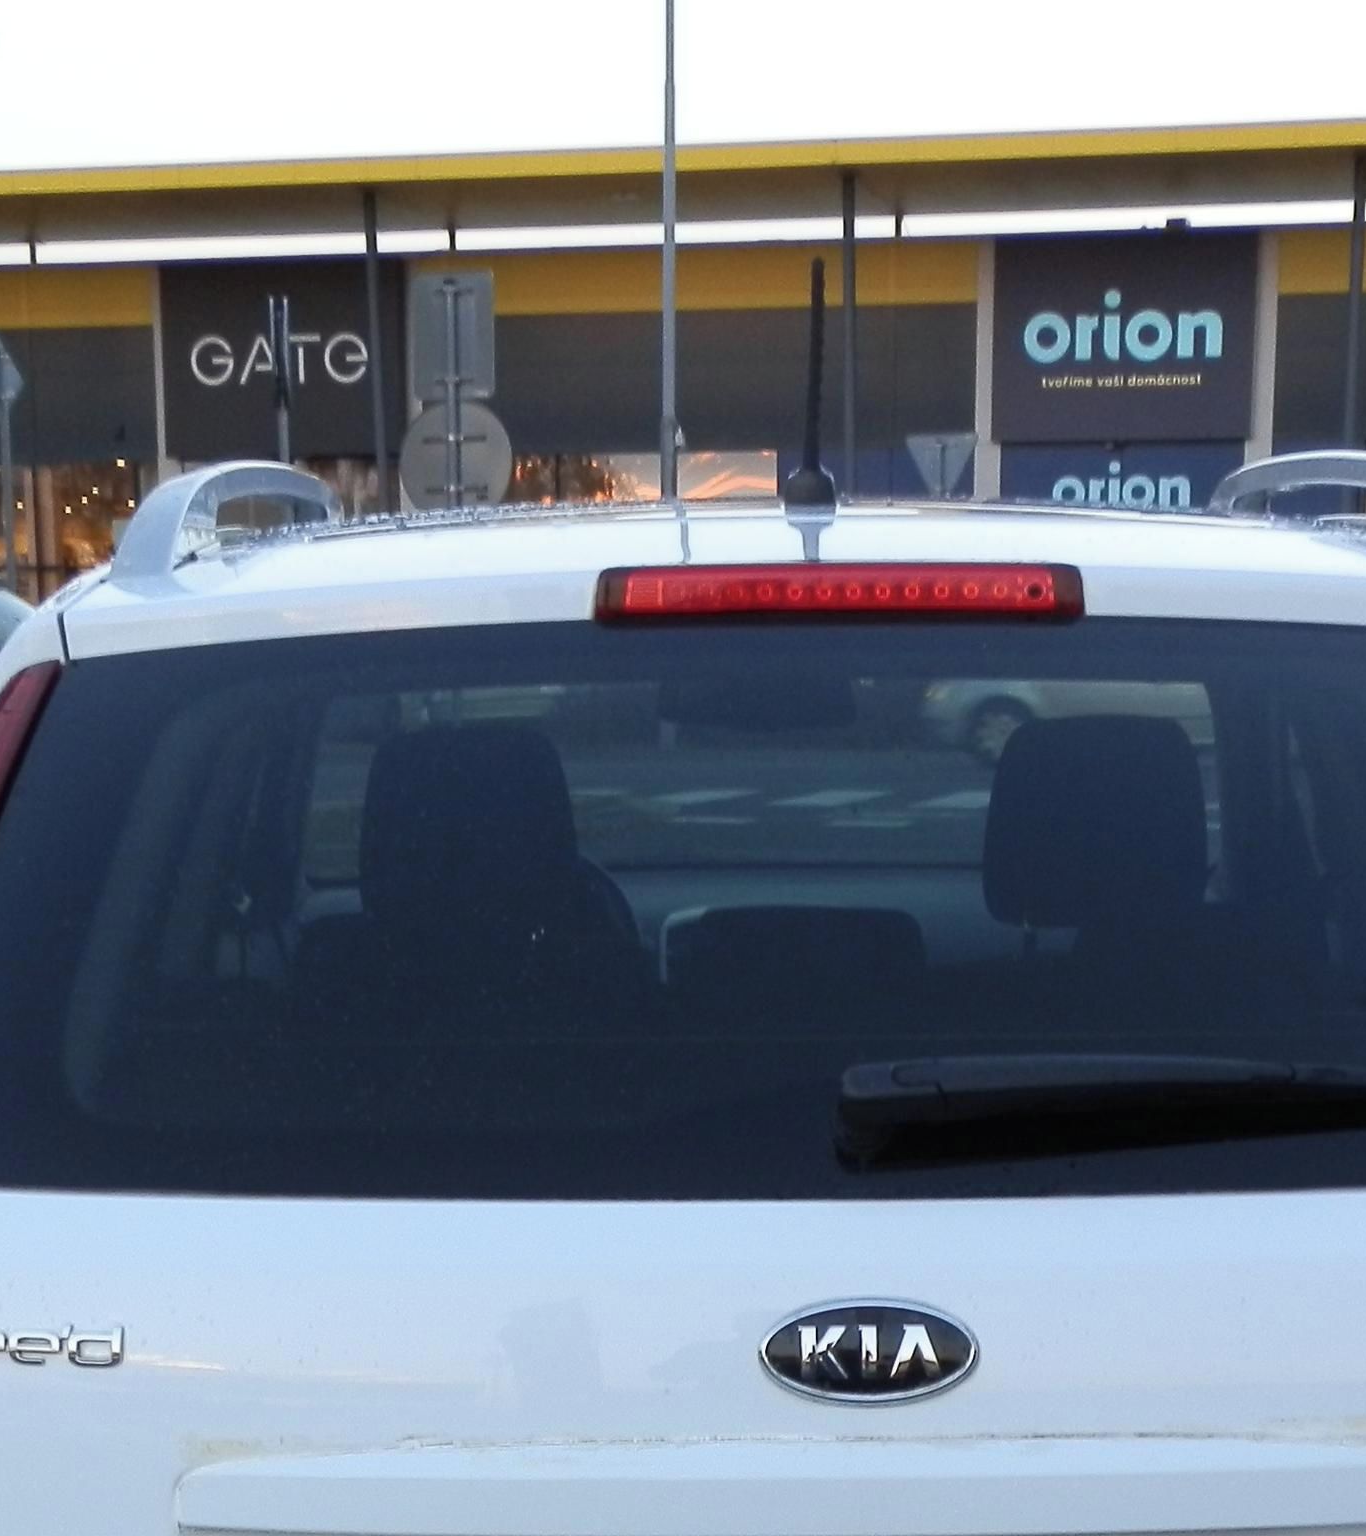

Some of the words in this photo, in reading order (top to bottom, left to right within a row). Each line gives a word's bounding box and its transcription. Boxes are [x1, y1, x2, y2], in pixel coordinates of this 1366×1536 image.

[1022, 288, 1224, 364] orion
[1052, 460, 1191, 510] orion
[797, 1323, 941, 1379] KIA
